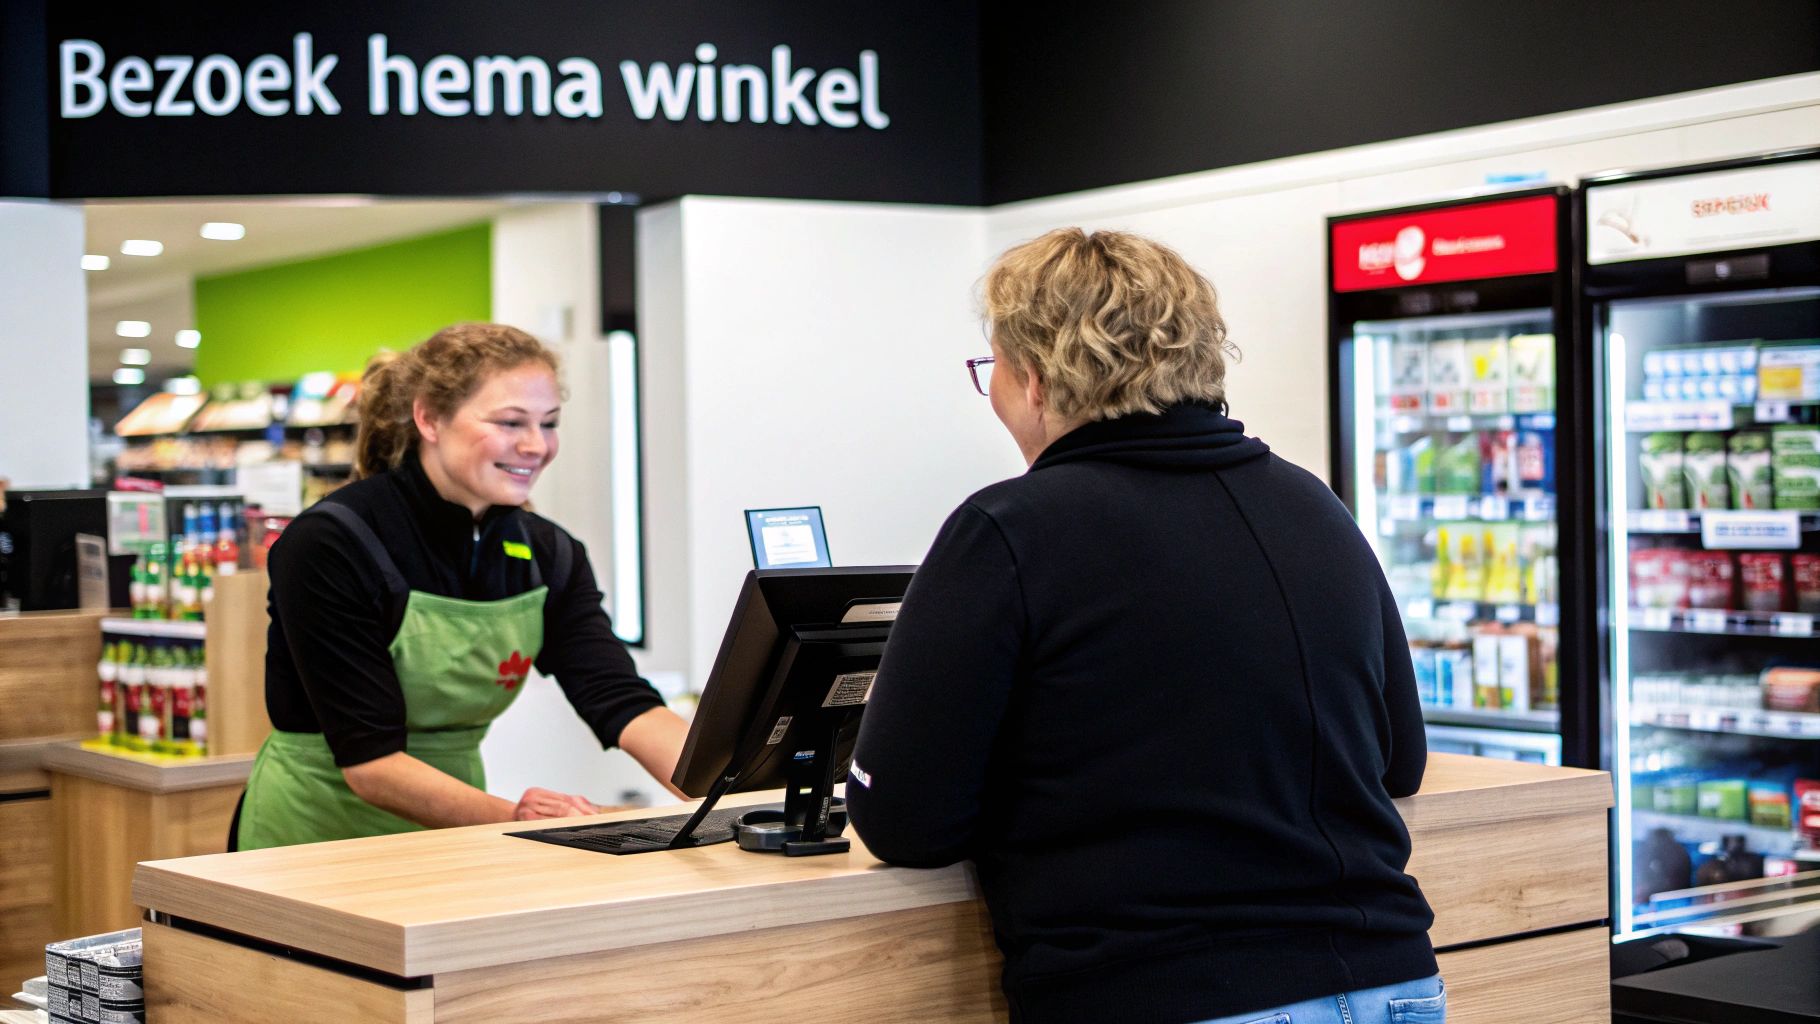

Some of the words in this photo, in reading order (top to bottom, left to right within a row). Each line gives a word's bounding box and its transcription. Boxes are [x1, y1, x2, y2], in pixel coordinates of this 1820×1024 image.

[60, 33, 341, 118] Bezoek
[368, 34, 603, 117] hema
[620, 43, 890, 129] winkel
